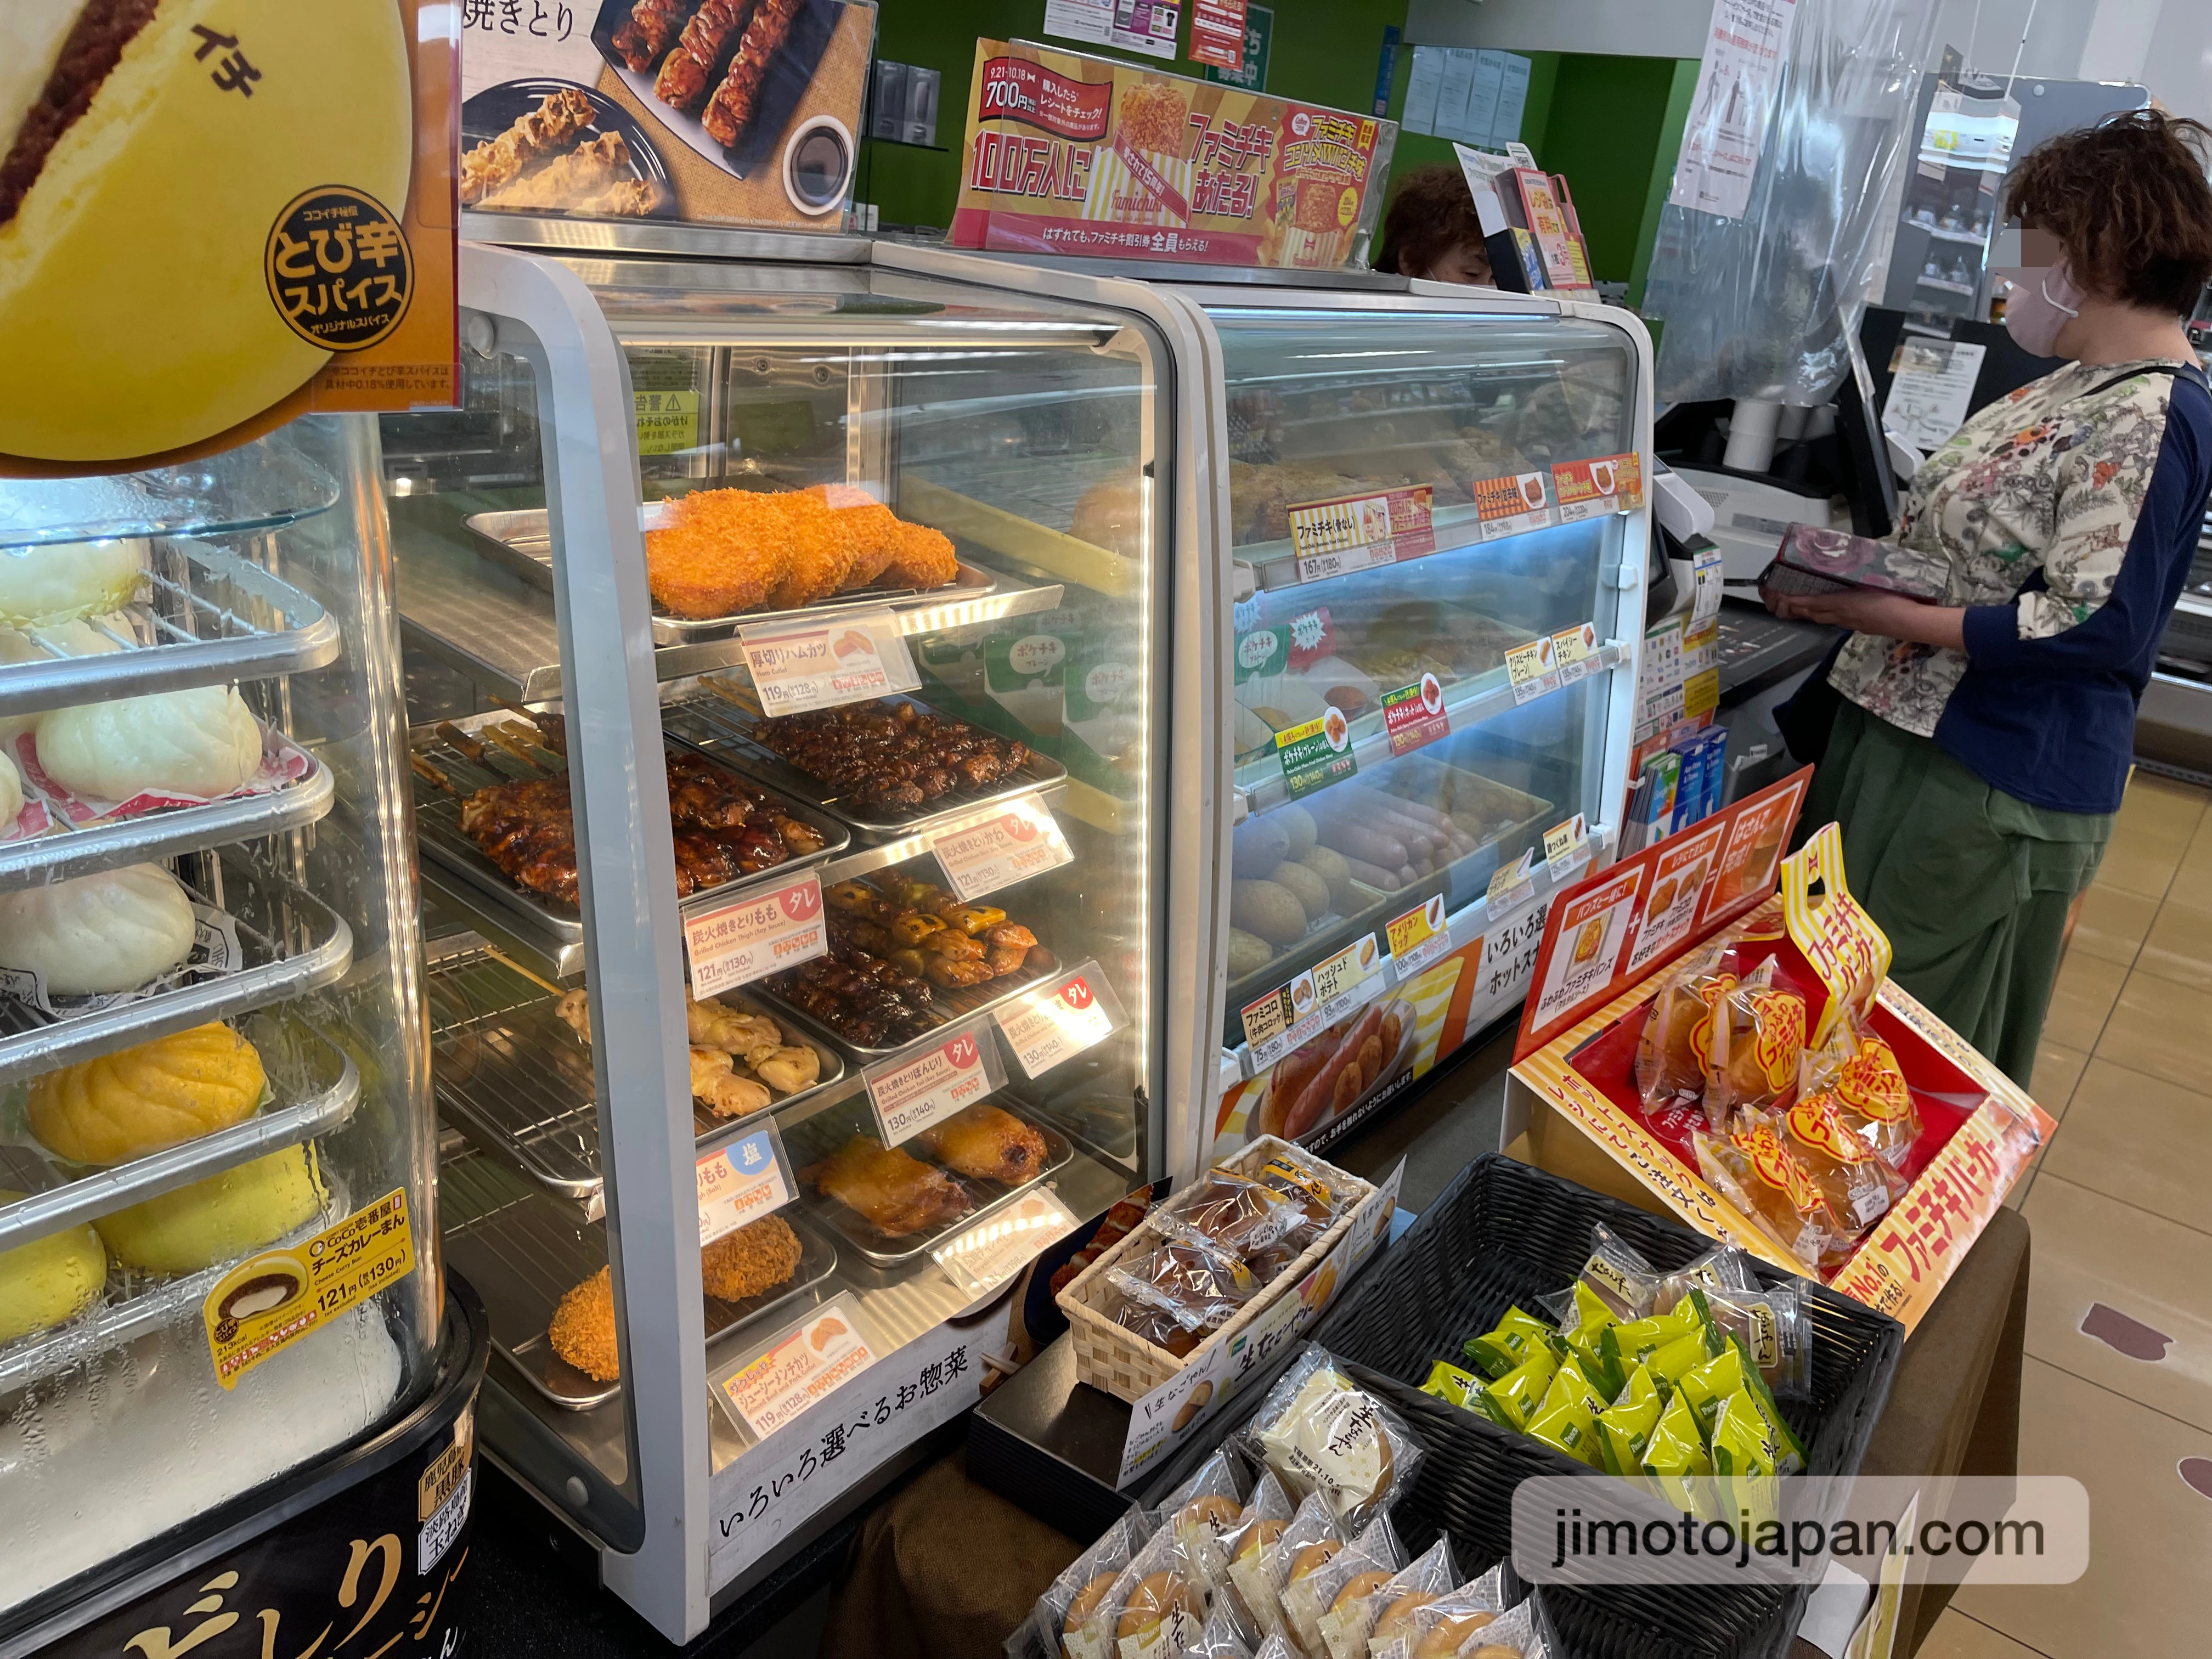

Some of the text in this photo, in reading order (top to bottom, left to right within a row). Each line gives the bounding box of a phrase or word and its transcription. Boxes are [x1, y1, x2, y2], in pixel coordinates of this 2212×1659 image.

[190, 22, 262, 98] イチ
[1189, 112, 1274, 174] ファミチキ
[971, 129, 1092, 200] 100万人に
[1192, 168, 1259, 219] あたる!
[276, 221, 398, 279] とび辛
[285, 274, 403, 316] スパイス
[311, 313, 391, 335] オリジナルスパイス
[1297, 515, 1355, 540] ファミチキ(骨なし)
[750, 643, 827, 668] 厚切りハムカツ
[1017, 641, 1057, 658] ポケチキ
[1244, 636, 1272, 653] ポケチキ
[941, 827, 1005, 860] 炭火焼きとりかわ
[789, 888, 816, 913] タレ
[692, 904, 777, 946] 炭火焼きとりもも
[1390, 916, 1418, 940] アメリカン
[1807, 892, 1860, 980] ファミチキ
[694, 945, 714, 956] Grilled
[714, 936, 737, 949] Chicken
[737, 931, 754, 944] Thigh
[754, 927, 768, 939] (Soy
[1392, 932, 1408, 953] ドッグ
[1317, 956, 1348, 984] ハッシュド
[1068, 984, 1087, 1005] タレ
[1320, 977, 1339, 997] ポテト
[1246, 999, 1278, 1026] ファミコロ
[1249, 1011, 1284, 1041] (牛肉コロッケ)
[952, 1039, 973, 1063] タレ
[881, 1094, 898, 1105] Grilled
[898, 1085, 916, 1097] Chicken
[916, 1080, 924, 1088] Tail
[743, 1143, 763, 1166] 塩
[1562, 1075, 1717, 1209] ホットスナックは
[706, 1183, 722, 1197] (Salt)
[1880, 1132, 2001, 1283] ファミチキバーガー
[312, 1214, 406, 1277] チーズカレーまん
[314, 1255, 363, 1286] Cheese Curry Bun
[368, 1268, 400, 1293] (tax included)
[333, 1295, 357, 1313] excluded
[217, 1334, 249, 1357] 213kcal
[730, 1361, 768, 1395] ザクじゅわ
[740, 1352, 809, 1410] ジューシーメンチカツ
[747, 1362, 817, 1416] Minced Beef and Pork Cutlet
[1702, 1400, 1719, 1417] Pasco
[719, 1345, 968, 1537] いろいろ選べるお惣菜
[1563, 1425, 1581, 1443] Pasco
[1630, 1436, 1645, 1454] Pasco
[433, 1454, 465, 1508] 黒豚
[427, 1496, 467, 1566] 玉ねぎ
[1138, 1624, 1160, 1643] Pasco
